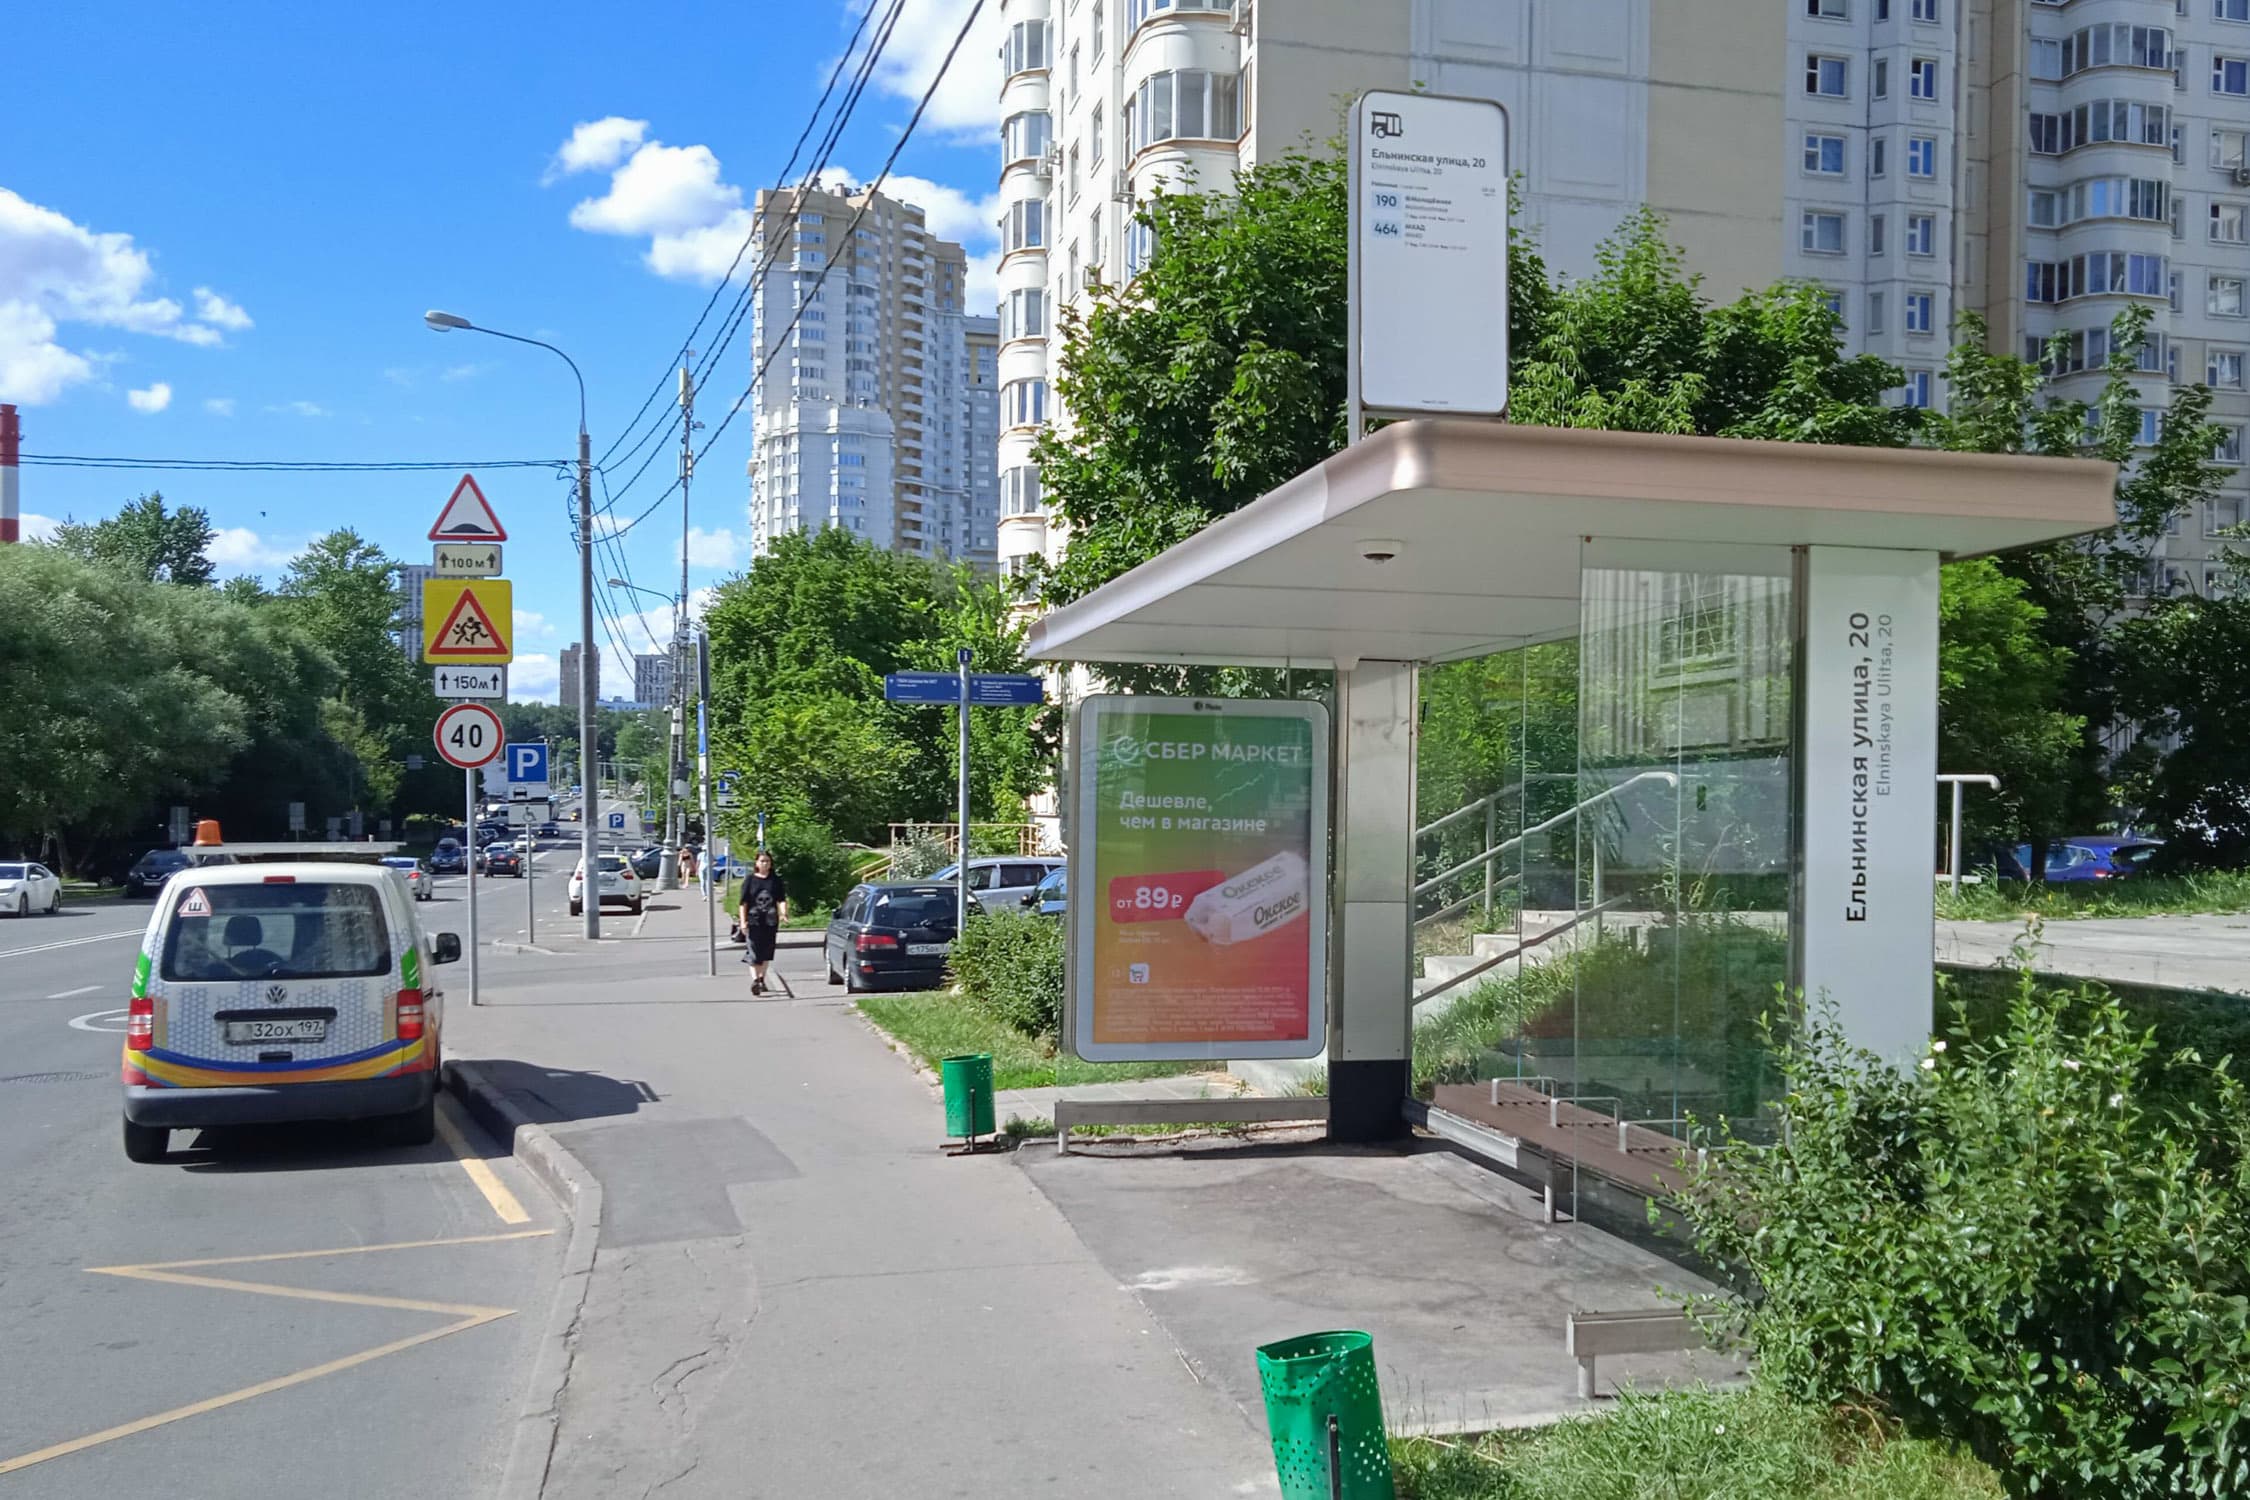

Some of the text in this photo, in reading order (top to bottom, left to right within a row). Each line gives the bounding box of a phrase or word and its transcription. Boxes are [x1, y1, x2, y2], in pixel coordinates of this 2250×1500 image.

[1371, 149, 1486, 168] Ельнинская улица, 20
[1375, 194, 1397, 207] 190
[1374, 223, 1398, 235] 464
[1876, 613, 1894, 797] Elninskaya Ulitsa, 20
[451, 724, 483, 748] 40
[516, 748, 540, 778] P
[1145, 741, 1303, 763] СБЕР МАРКЕТ
[1846, 612, 1873, 922] Ельнинская улица, 20
[1119, 790, 1213, 812] Дешевле,
[1119, 816, 1267, 832] чем в магазине
[188, 902, 202, 911] Ш
[1116, 899, 1133, 909] от
[1135, 886, 1169, 909] 89
[298, 1021, 320, 1032] 197
